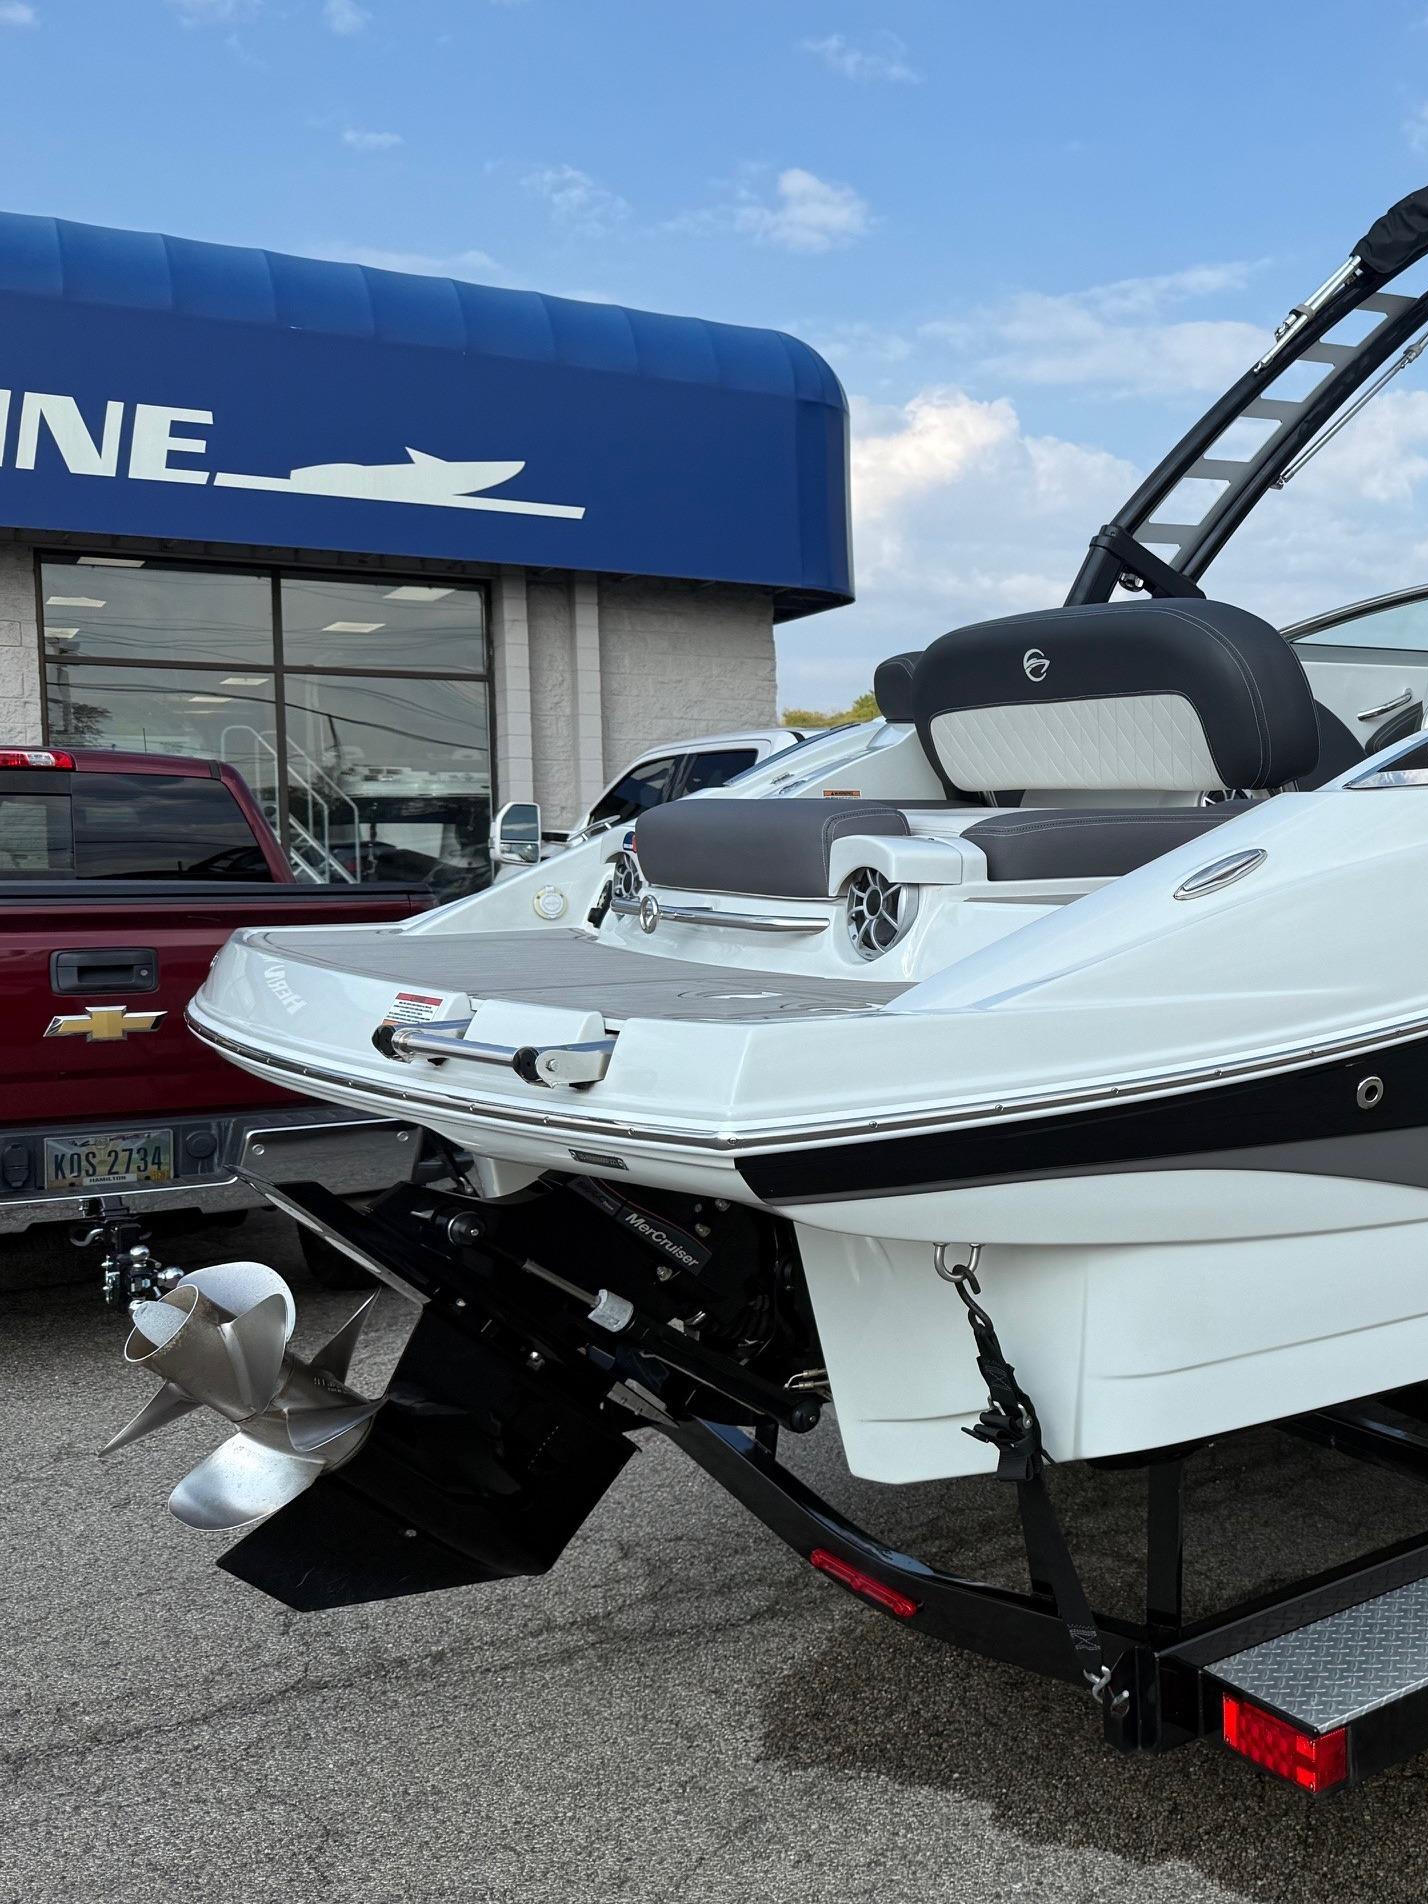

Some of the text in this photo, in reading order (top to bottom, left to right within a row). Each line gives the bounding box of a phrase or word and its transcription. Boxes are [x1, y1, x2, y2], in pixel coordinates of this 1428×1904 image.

[54, 1145, 163, 1180] KOS 2734
[625, 1212, 700, 1267] MerCruiser
